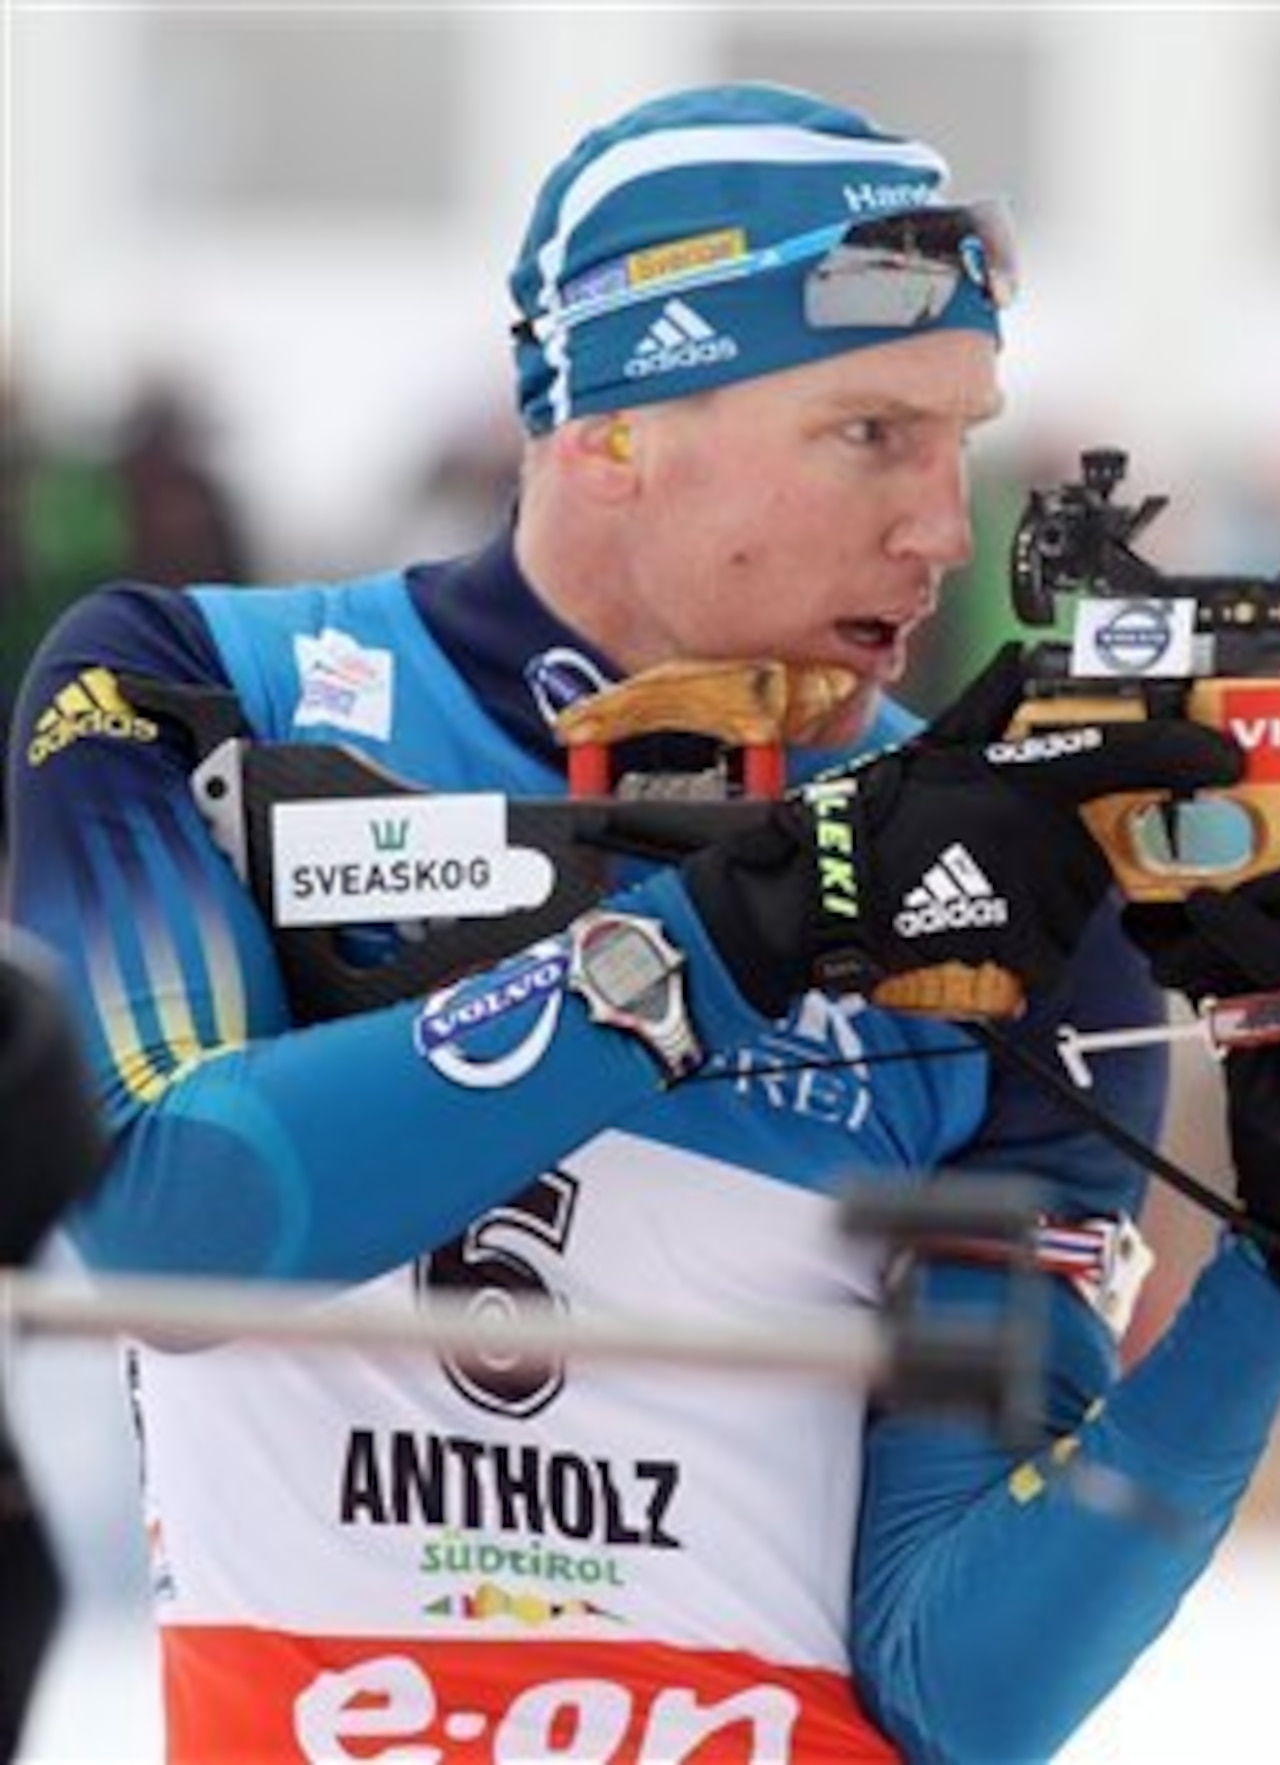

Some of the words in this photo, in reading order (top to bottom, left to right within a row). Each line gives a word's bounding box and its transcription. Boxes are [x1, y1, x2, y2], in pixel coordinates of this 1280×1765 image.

[623, 335, 738, 378] adidas
[28, 711, 158, 767] adidas
[986, 726, 1103, 763] adidas
[293, 857, 490, 898] SVEASKOG
[814, 797, 860, 919] LEKI
[894, 898, 1009, 938] adidas
[429, 963, 561, 1034] VOLVO
[411, 1163, 580, 1419] 6
[338, 1429, 682, 1549] ANTHOLZ
